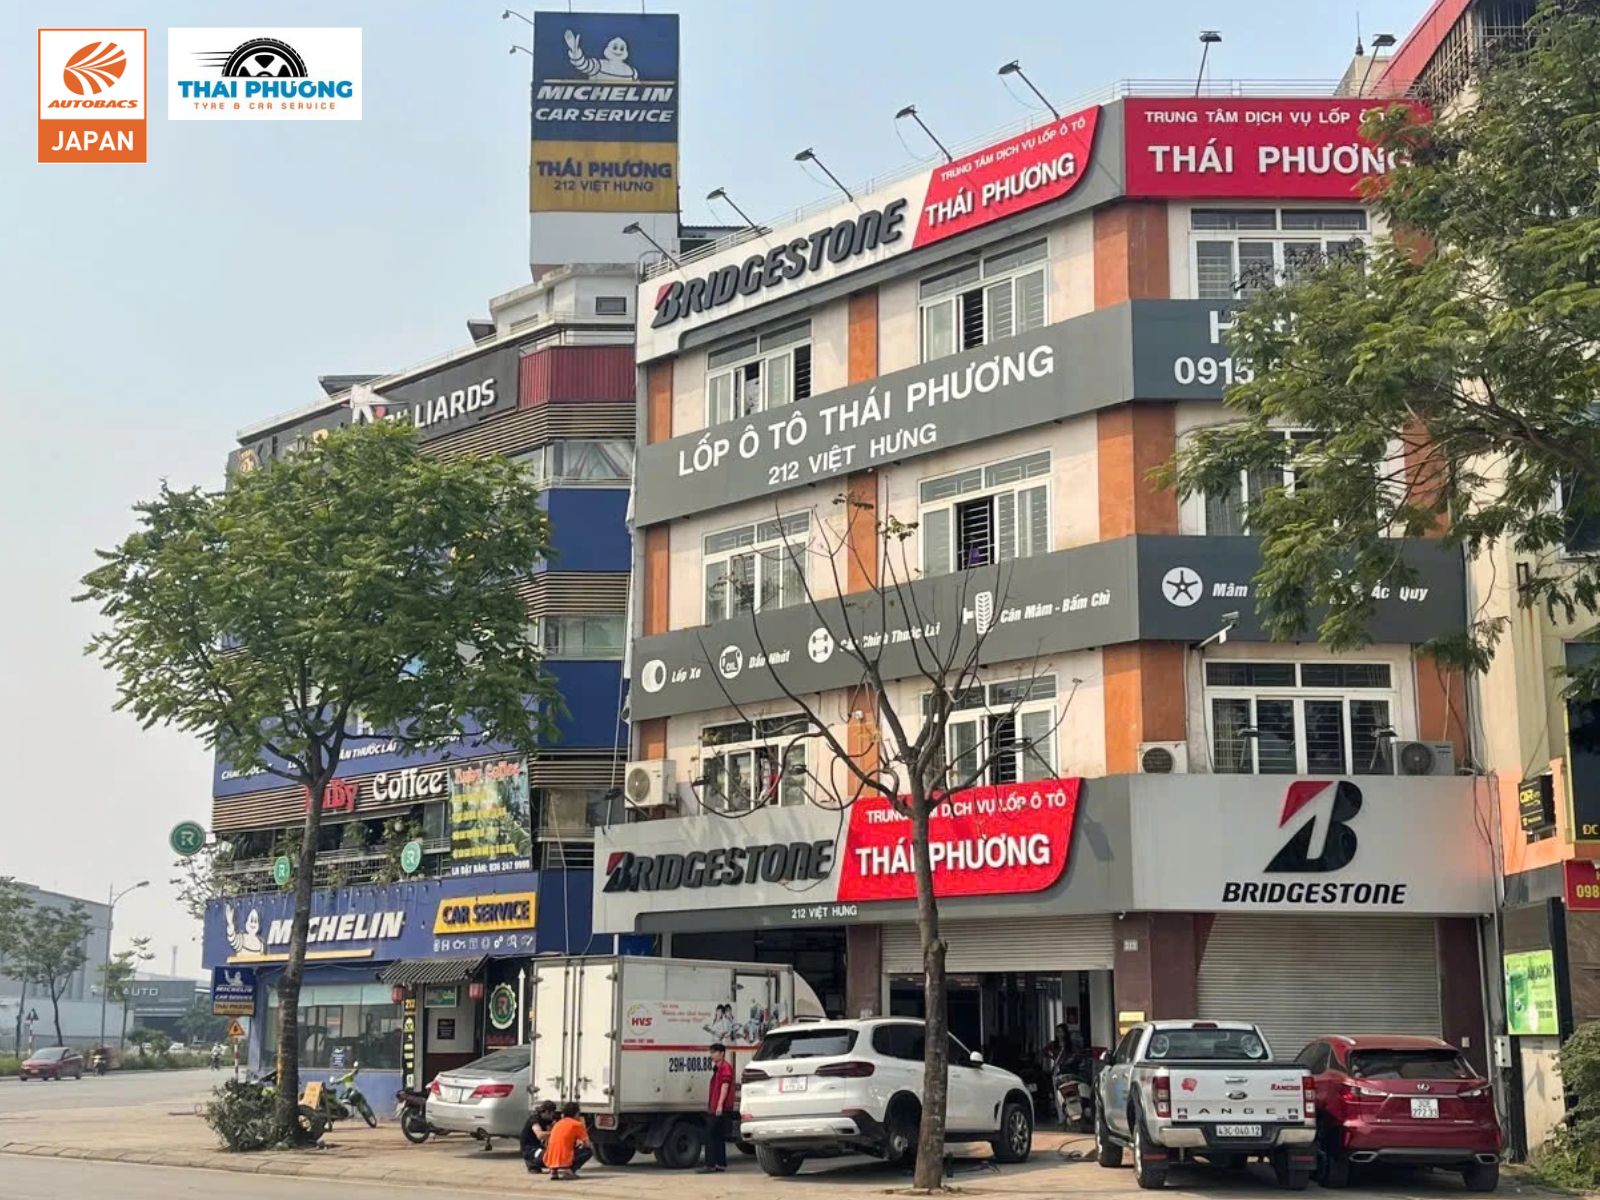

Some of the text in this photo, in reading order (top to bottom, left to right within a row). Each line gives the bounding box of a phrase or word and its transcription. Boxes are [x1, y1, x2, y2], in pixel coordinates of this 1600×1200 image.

[537, 85, 673, 102] MICHELIN
[535, 108, 674, 123] CAR SERVICE
[1145, 111, 1198, 123] TRUNG
[1206, 108, 1239, 123] TÂM
[1245, 111, 1283, 127] DỊCH
[1290, 111, 1312, 127] VỤ
[1319, 107, 1351, 123] LỐP
[940, 116, 1086, 183] TRUNG TÂM DỊCH VỤ LỐP Ô TÔ
[1148, 138, 1234, 173] THÁI
[537, 158, 672, 178] THÁI PHƯƠNG
[553, 180, 654, 193] 212 VIỆT HƯNG
[925, 152, 1075, 226] THÁI PHƯƠNG
[651, 198, 907, 328] BRIDGESTONE
[678, 344, 1054, 476] LỐP Ô TÔ THÁI PHƯƠNG
[768, 422, 938, 485] 212 VIỆT HƯNG
[1212, 582, 1248, 598] Mâm
[1062, 594, 1088, 612] Bấm
[689, 667, 702, 680] Xe
[373, 767, 444, 802] Coffee
[1030, 791, 1041, 809] Ô
[1045, 788, 1066, 808] TÔ
[603, 839, 834, 893] BRIDGESTONE
[855, 836, 916, 876] THÁI
[1222, 882, 1407, 904] BRIDGESTONE
[443, 901, 530, 923] CAR SERVICE
[791, 908, 806, 919] 212
[267, 911, 404, 945] MCHELIN
[1177, 1107, 1299, 1115] RANGER
